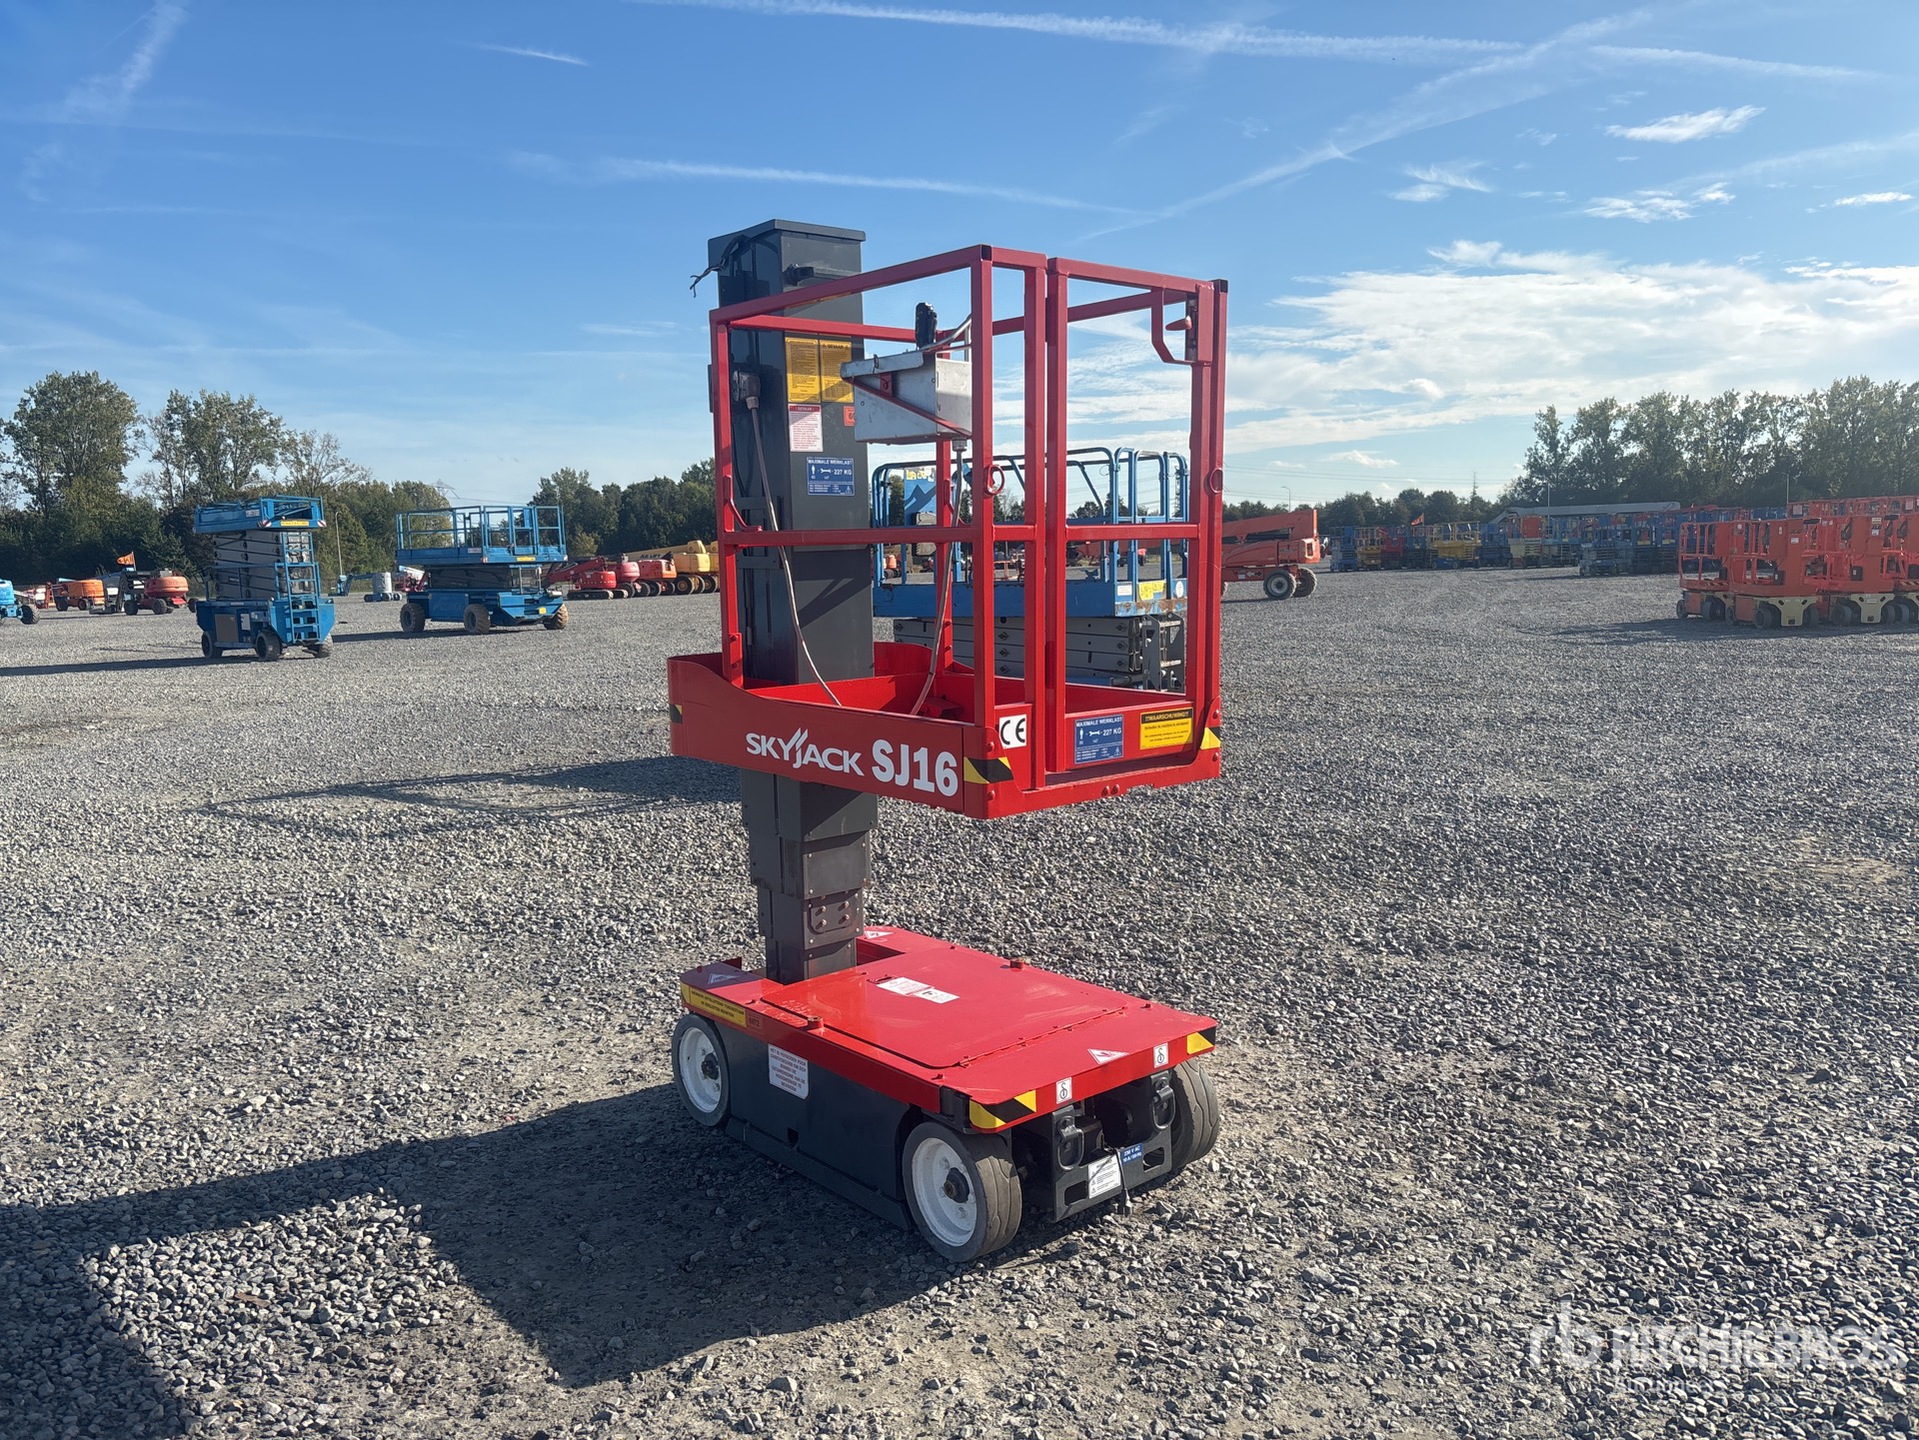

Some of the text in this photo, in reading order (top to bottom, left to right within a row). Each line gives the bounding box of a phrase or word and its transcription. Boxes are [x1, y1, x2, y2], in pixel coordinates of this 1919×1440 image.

[1076, 716, 1123, 727] MAXIMALE WERKLAST
[1102, 727, 1122, 737] 227 KG
[745, 727, 959, 797] SKYJACK SJ16
